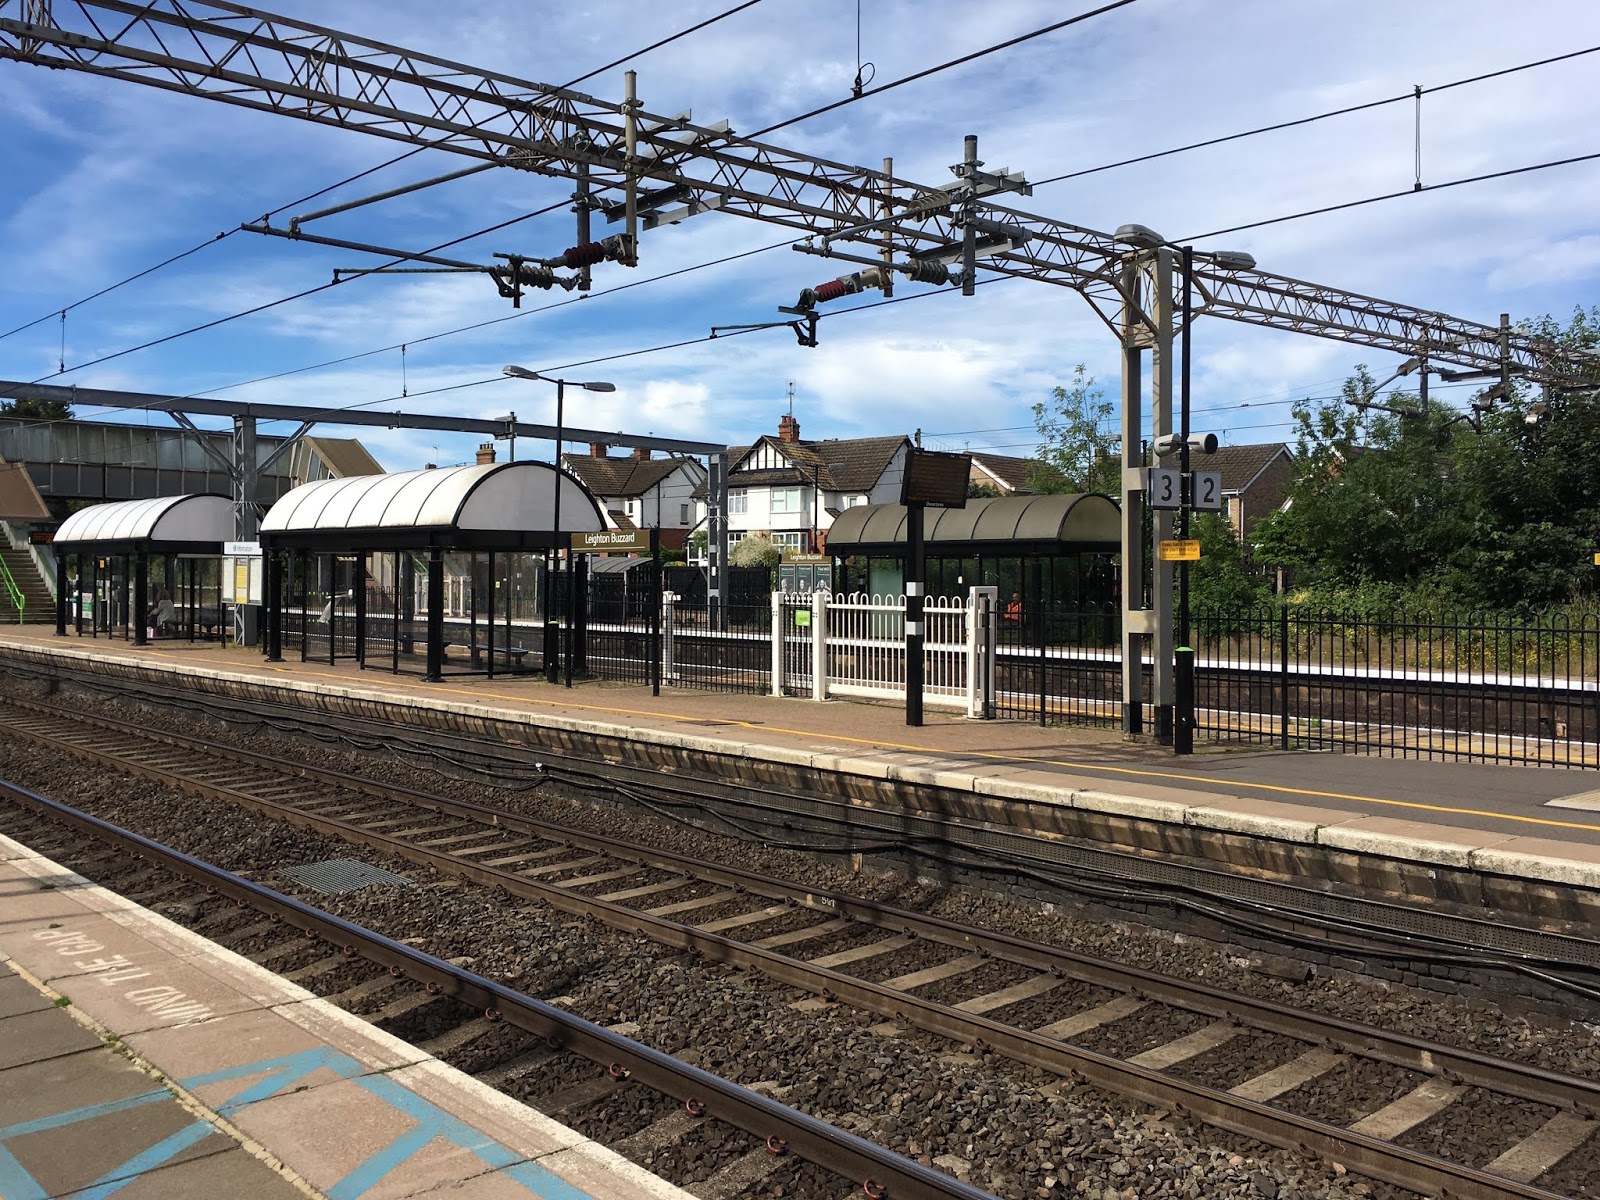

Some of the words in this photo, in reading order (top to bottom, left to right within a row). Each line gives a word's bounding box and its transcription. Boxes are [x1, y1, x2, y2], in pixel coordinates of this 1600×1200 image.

[1160, 474, 1173, 502] 3
[1203, 477, 1215, 503] 2
[585, 534, 610, 546] Leighton
[611, 532, 635, 543] Buzzard
[33, 931, 105, 956] GAP
[124, 985, 228, 1029] MIND
